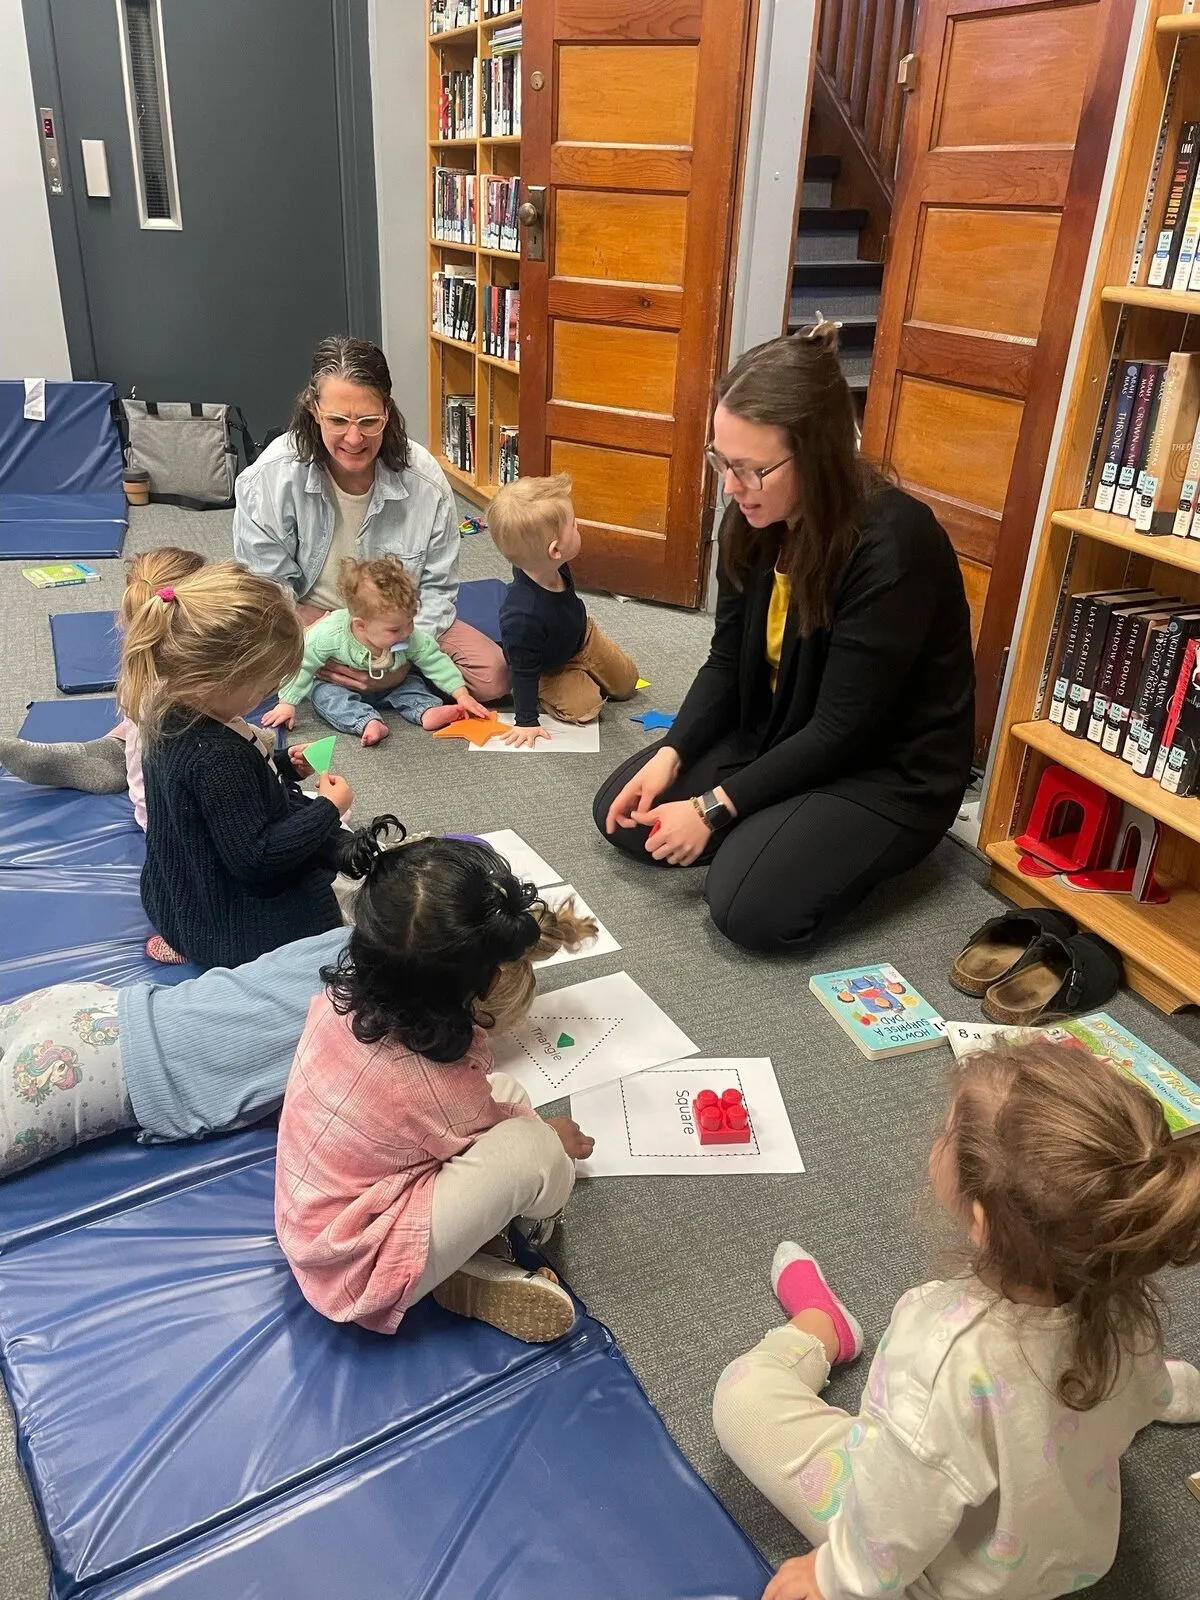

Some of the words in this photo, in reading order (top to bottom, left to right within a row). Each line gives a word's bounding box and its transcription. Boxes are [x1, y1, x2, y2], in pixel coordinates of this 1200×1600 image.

[1164, 186, 1184, 226] NUMBER
[1146, 374, 1155, 398] SARAH
[1112, 412, 1127, 450] THRONE
[1132, 406, 1146, 443] CROWN
[1066, 603, 1082, 654] FROSTBITE
[1088, 606, 1098, 630] LAST
[1110, 616, 1125, 661] SHADOW
[1126, 622, 1140, 656] SPIRIT
[1166, 630, 1183, 660] NIGHT
[1076, 632, 1092, 682] SACRIFICE
[1104, 663, 1114, 685] KISS
[1118, 660, 1132, 696] BOUND
[1140, 670, 1156, 712] PROMISE
[873, 1029, 884, 1037] A
[880, 1014, 904, 1025] DAD
[884, 1018, 930, 1034] SURPRISE
[906, 1028, 931, 1040] HOW
[958, 1028, 968, 1038] 8
[1092, 1020, 1140, 1050] DUCK
[531, 1026, 562, 1061] Triangle
[890, 1034, 907, 1042] TO
[674, 1090, 695, 1135] Square
